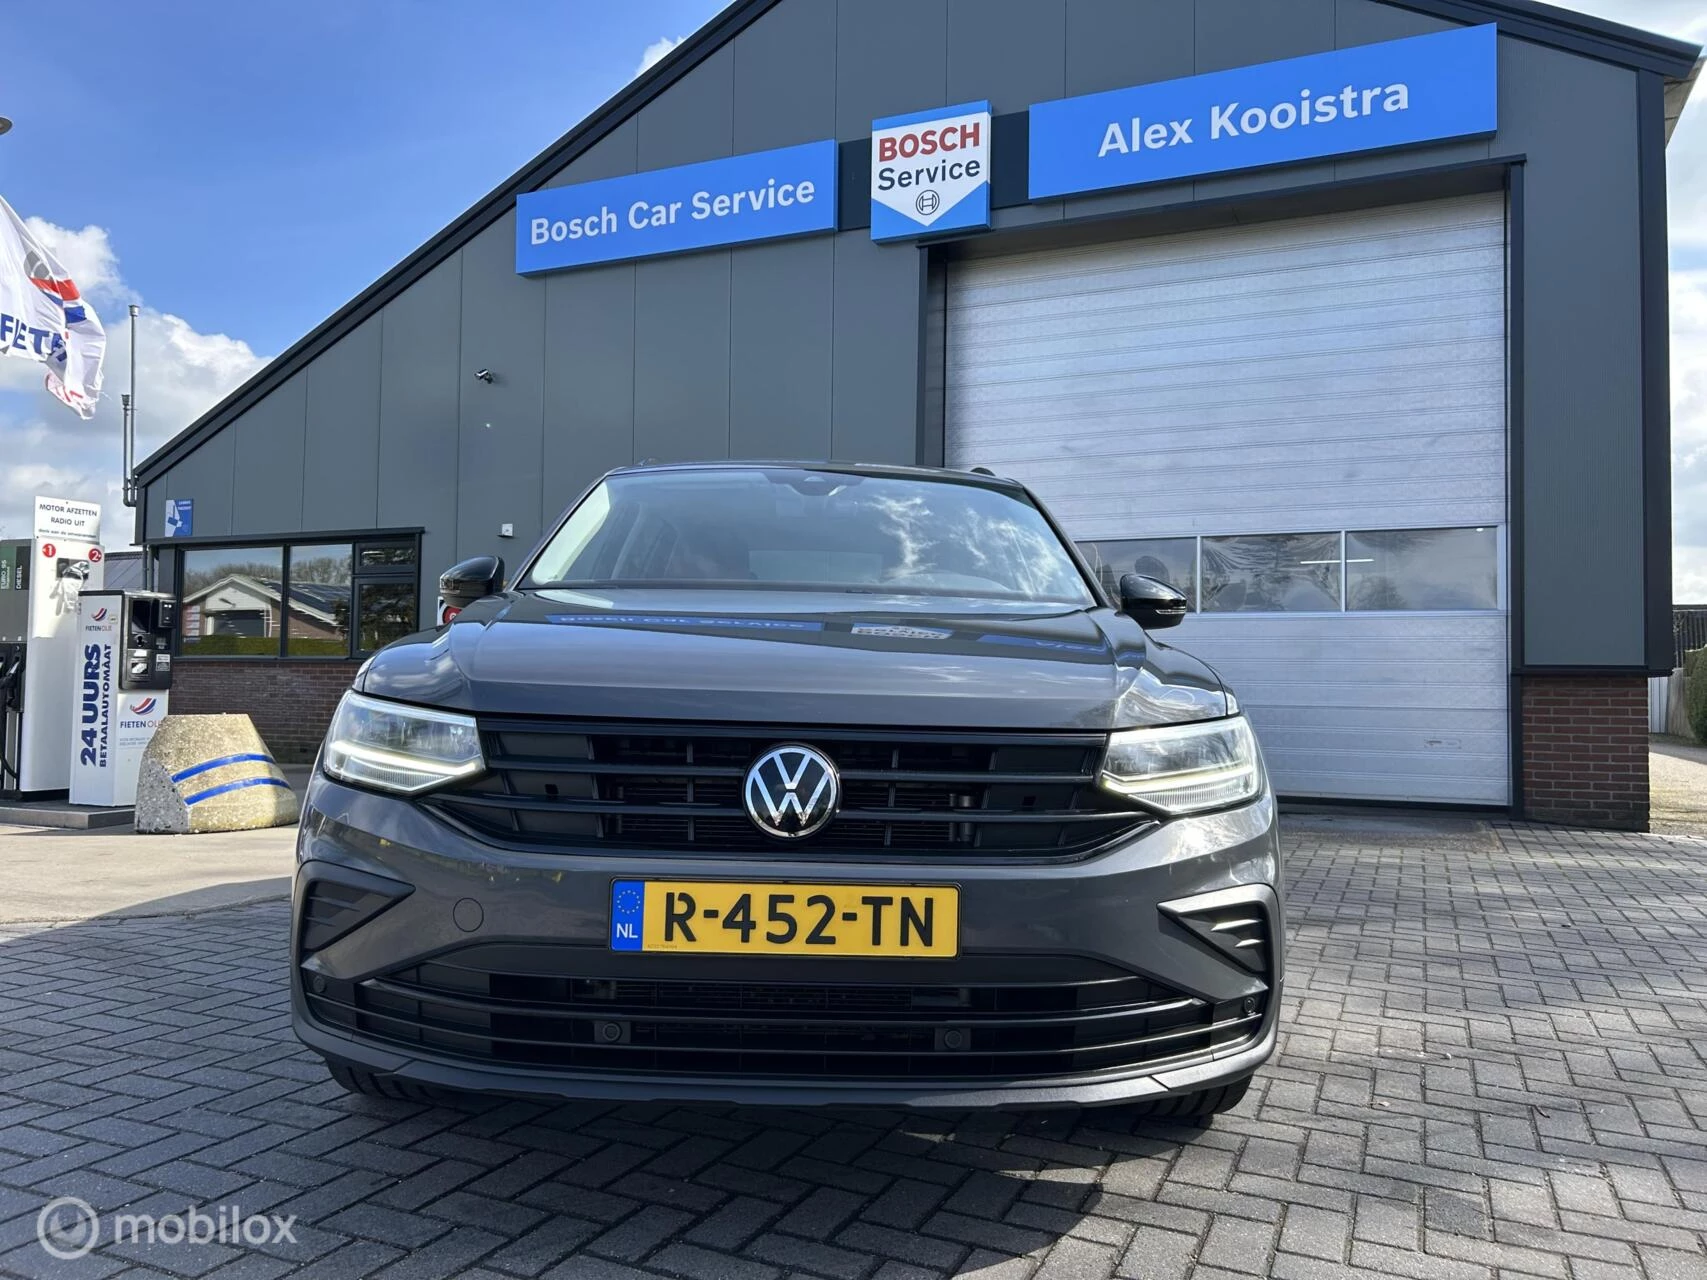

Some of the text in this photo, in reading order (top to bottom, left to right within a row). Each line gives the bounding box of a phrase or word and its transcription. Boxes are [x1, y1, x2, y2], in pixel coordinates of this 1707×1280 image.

[1098, 82, 1409, 158] Alex Kooistra
[878, 122, 981, 162] BOSCH
[877, 158, 981, 191] Service
[530, 178, 816, 246] Bosch Car Service
[39, 503, 97, 516] MOTOR AFZETTEN
[50, 517, 72, 525] RADIO
[15, 565, 23, 590] DIESEL
[80, 644, 100, 767] 24 UURS
[99, 644, 112, 767] BETAALAUTOMAAT
[120, 720, 147, 729] FIETEN
[615, 891, 934, 947] NL R-452-TN
